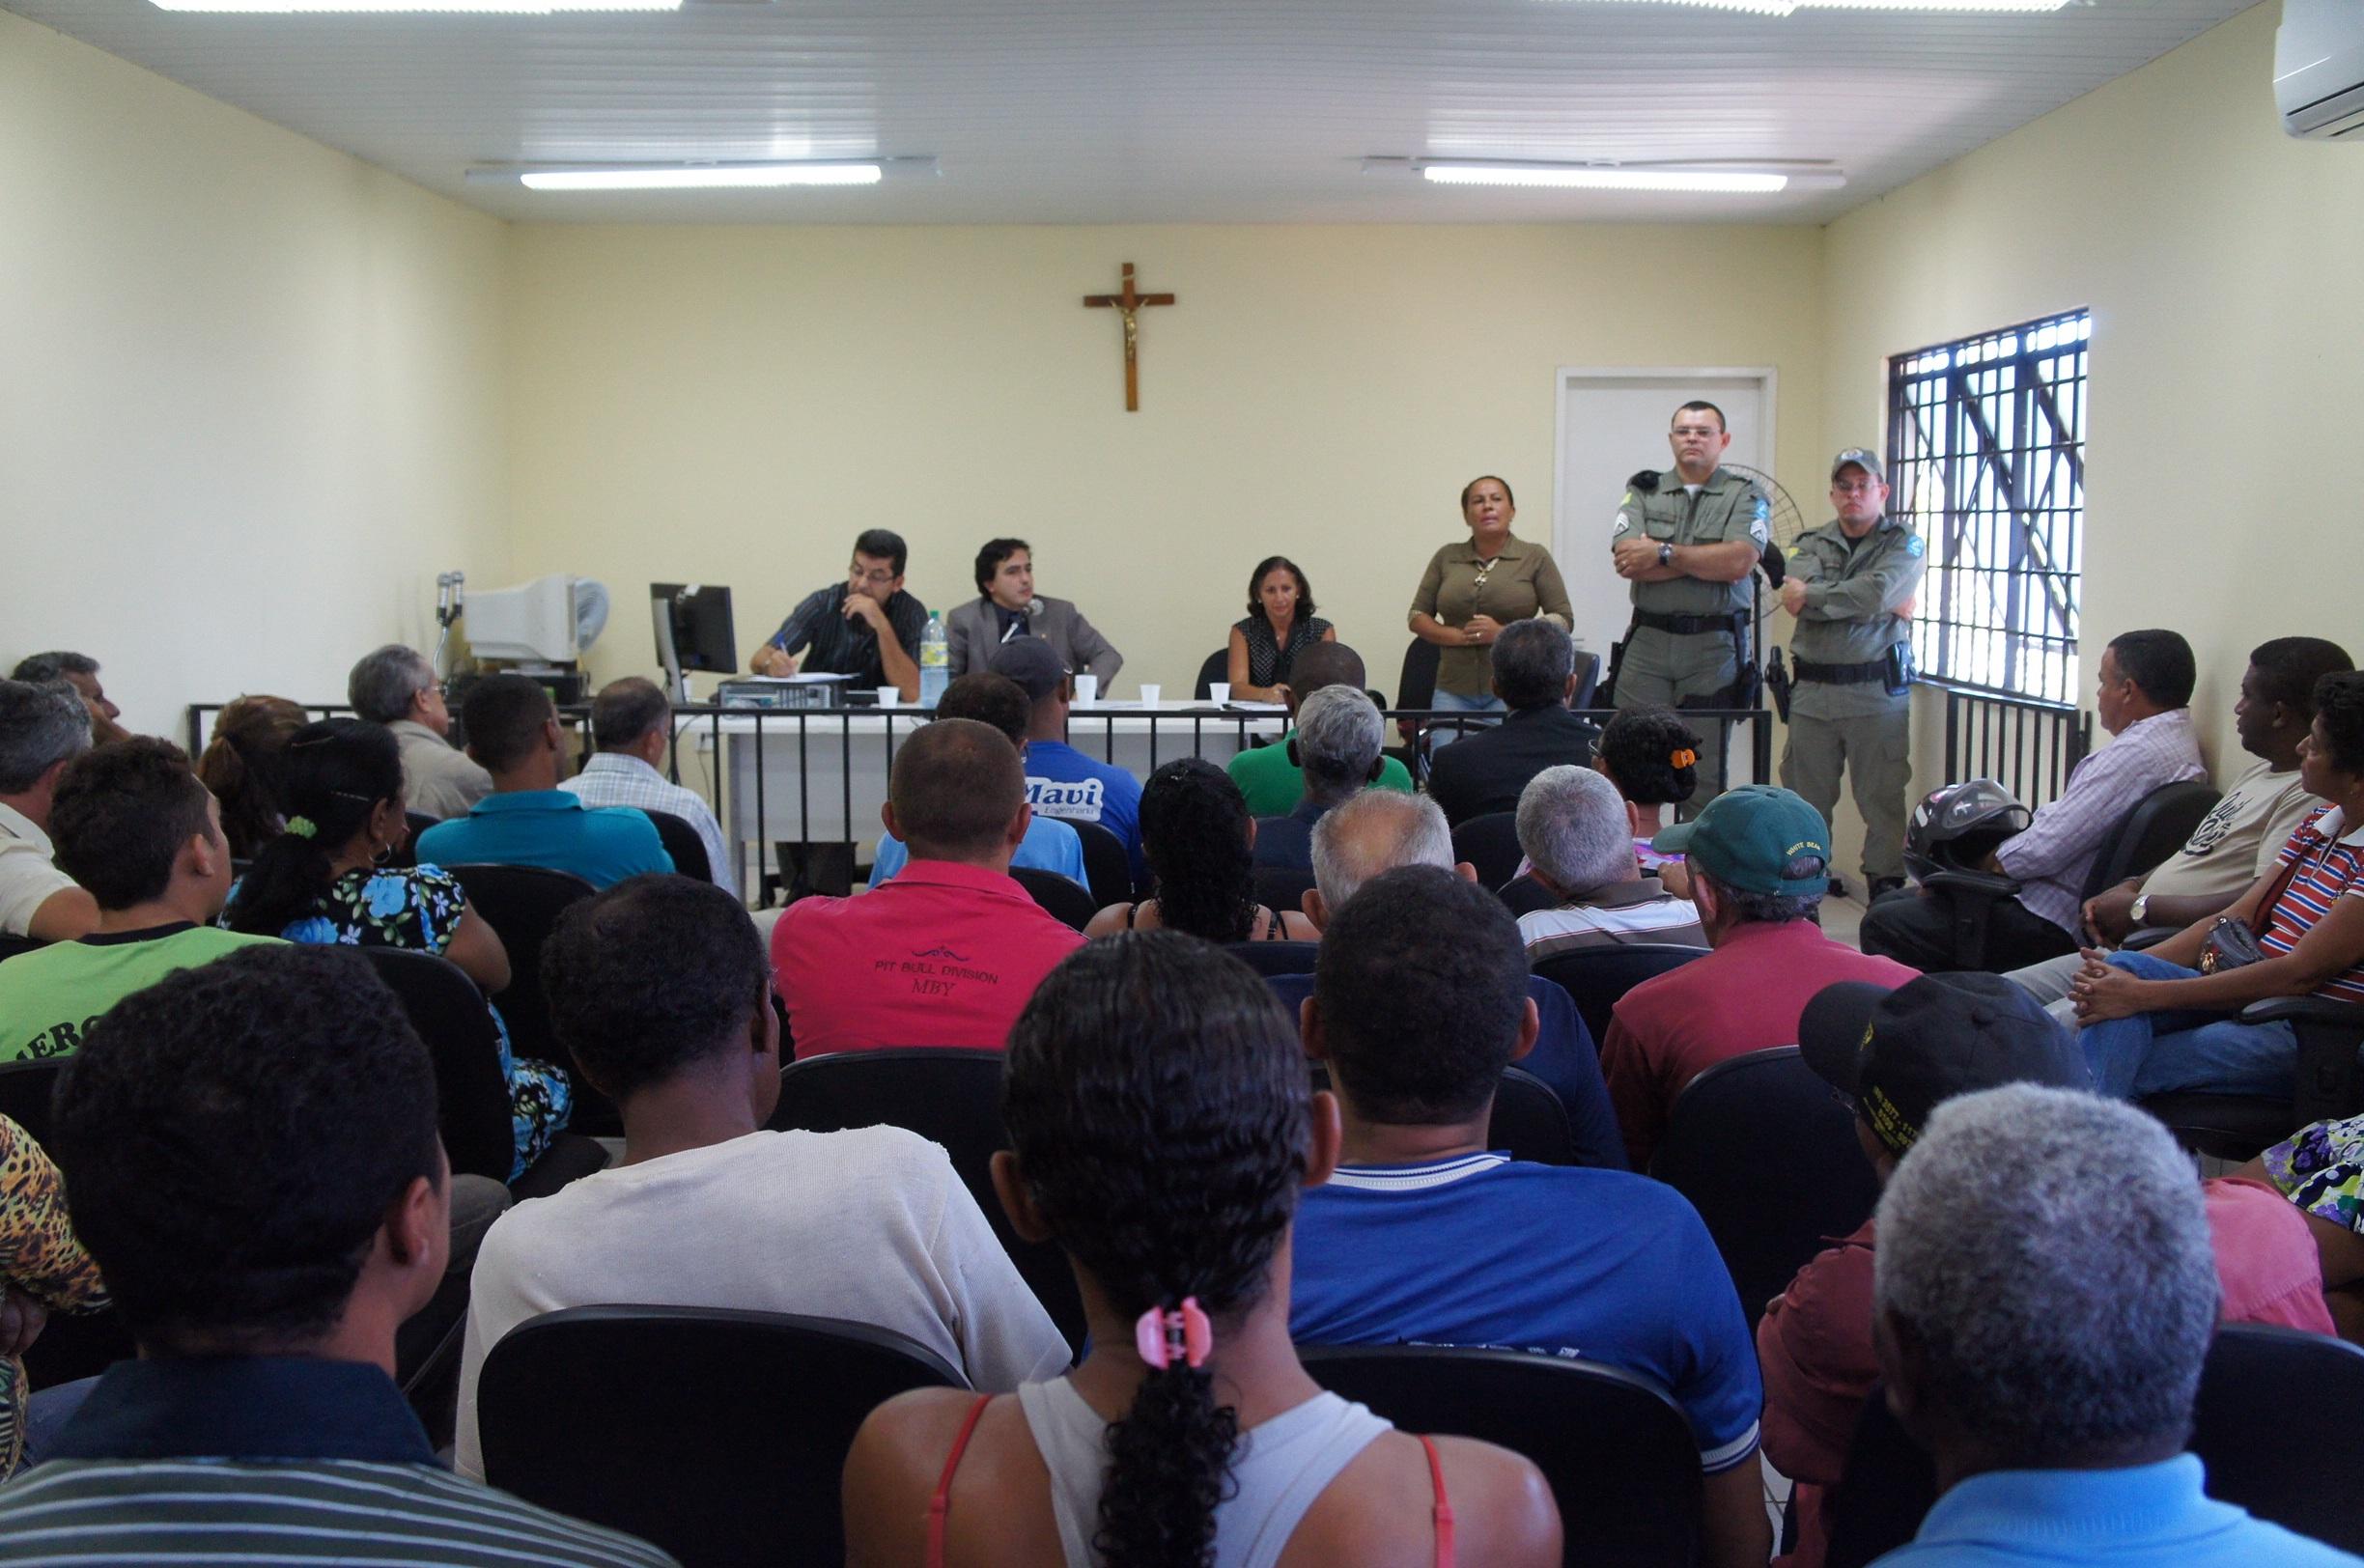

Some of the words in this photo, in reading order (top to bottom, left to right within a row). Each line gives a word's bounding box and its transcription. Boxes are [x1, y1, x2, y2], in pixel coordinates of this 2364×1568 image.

[1786, 841, 1805, 855] WHITE
[874, 960, 896, 971] PIT
[900, 962, 936, 974] BULL
[942, 966, 999, 985] DIVISION
[912, 978, 956, 996] MBY
[15, 1015, 102, 1060] ER
